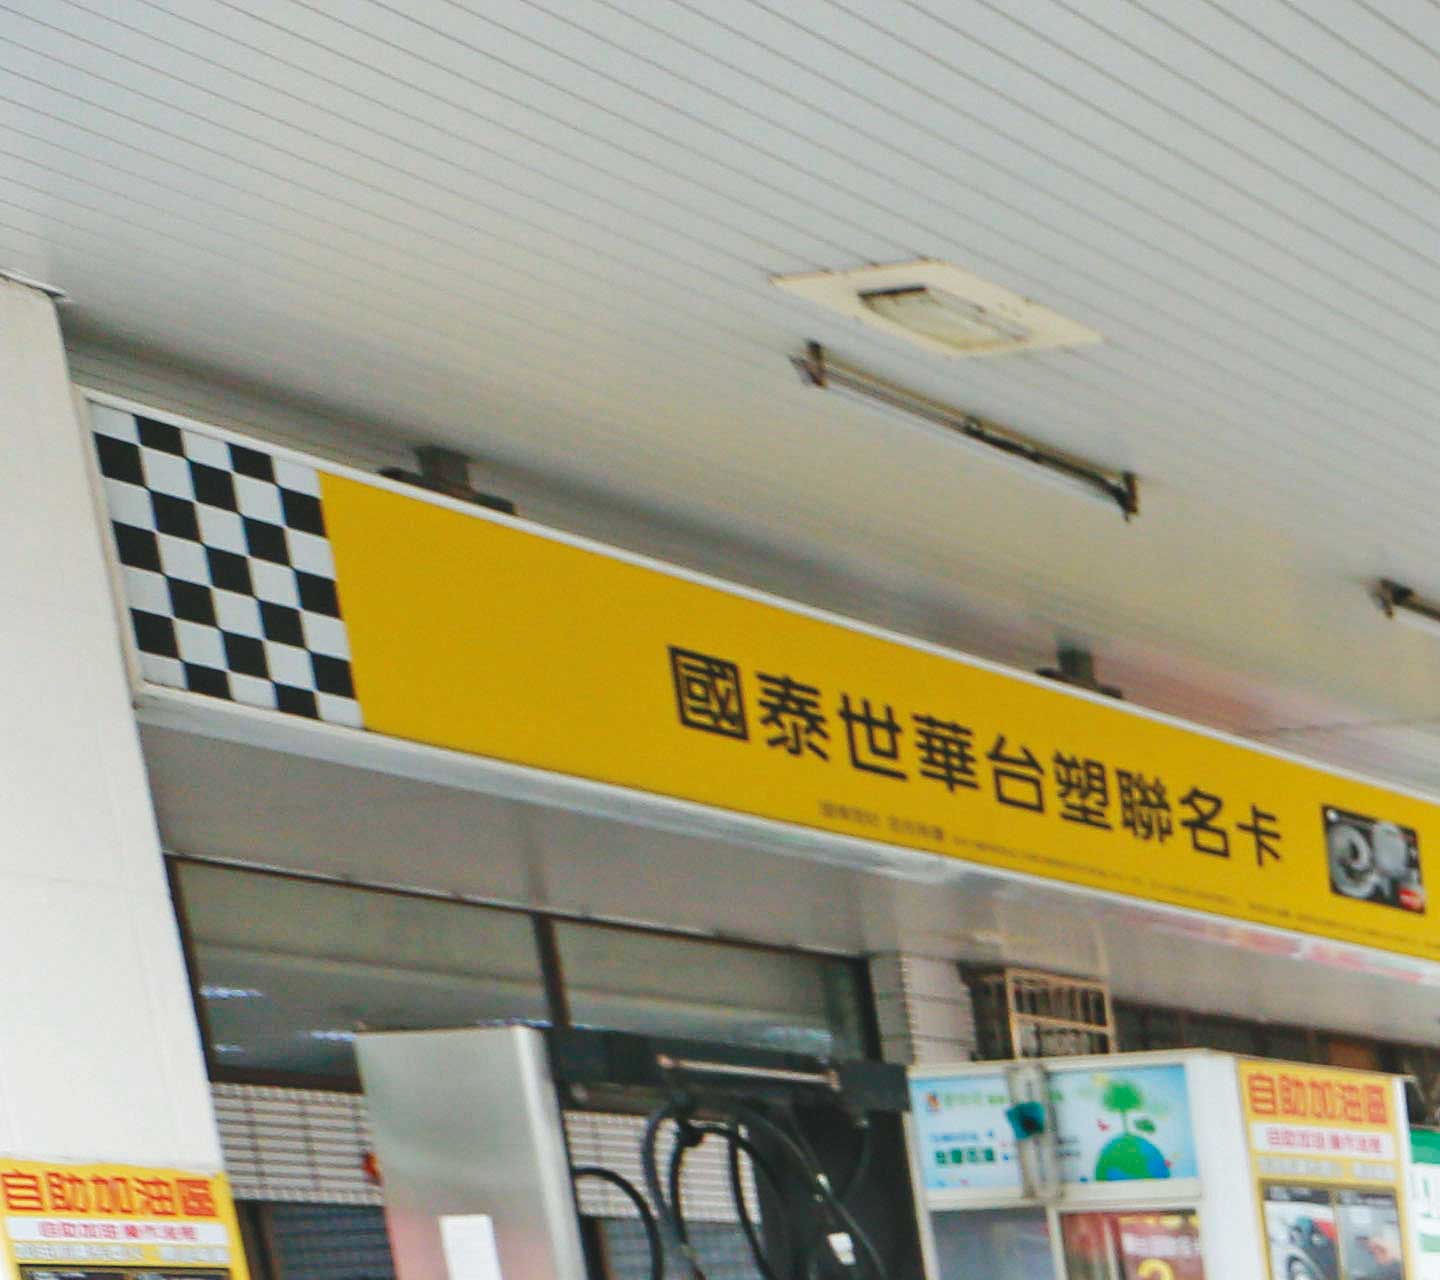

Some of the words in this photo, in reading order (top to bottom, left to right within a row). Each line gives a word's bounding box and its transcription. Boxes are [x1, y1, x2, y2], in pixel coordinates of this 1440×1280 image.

[667, 645, 1281, 867] 國泰世華台塑聯名卡
[1, 1169, 219, 1218] 自助加油區
